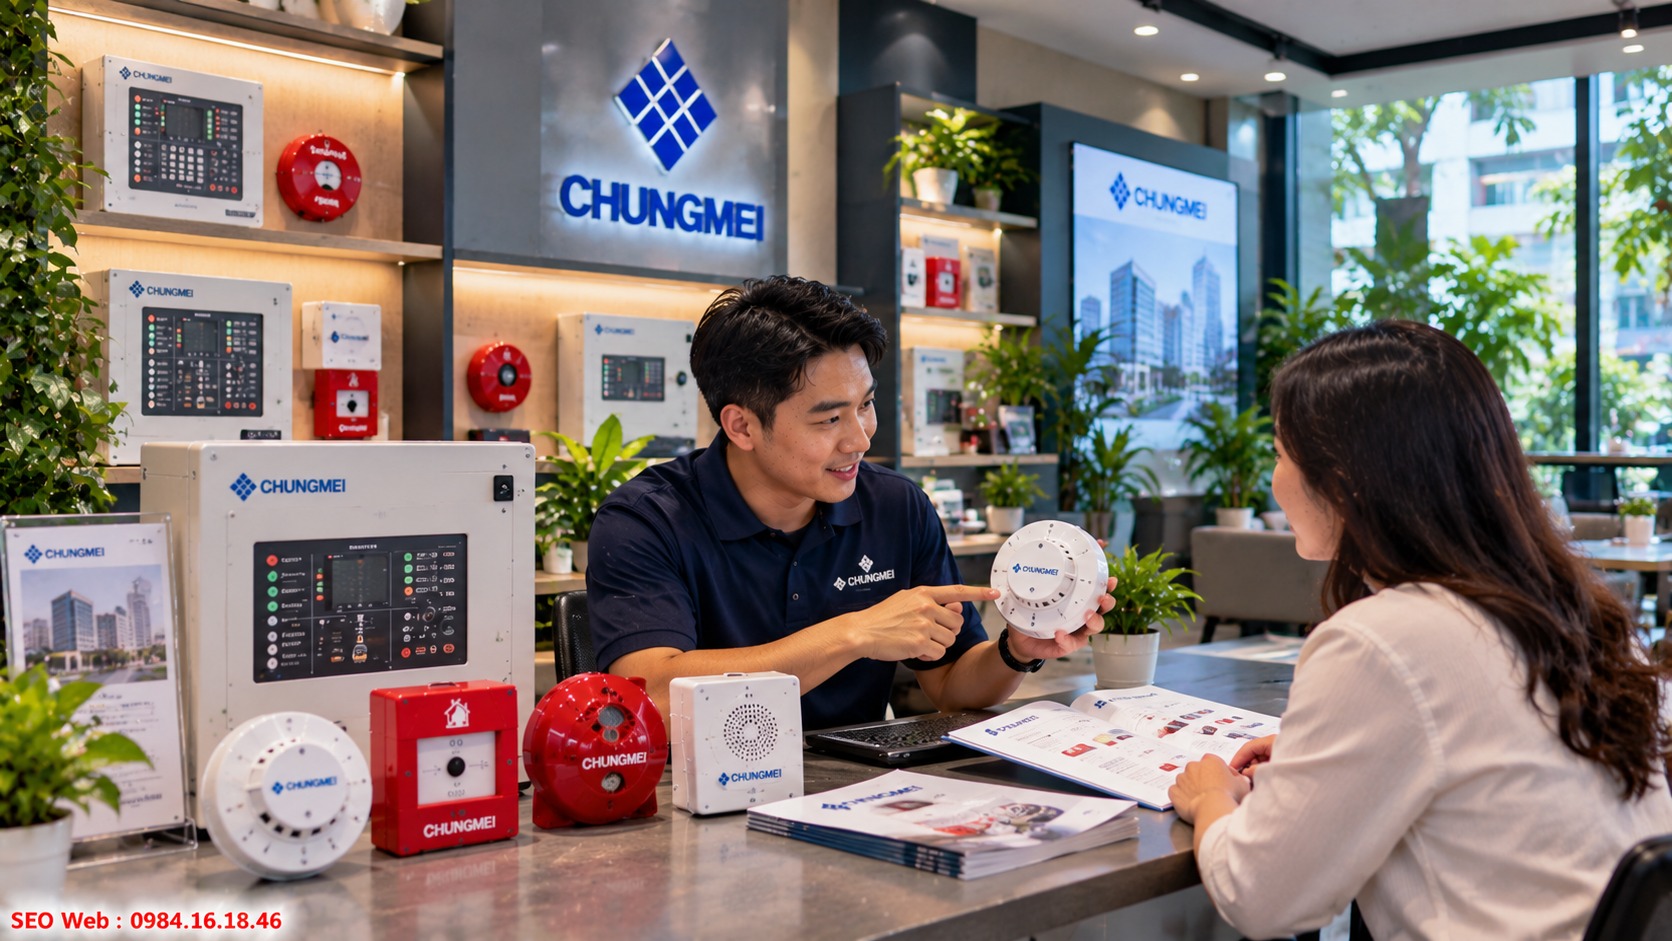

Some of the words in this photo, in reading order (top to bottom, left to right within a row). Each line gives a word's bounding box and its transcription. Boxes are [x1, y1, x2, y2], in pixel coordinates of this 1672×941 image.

[559, 174, 765, 242] CHUNGMEI
[1134, 186, 1207, 220] CHUNGMEI
[147, 286, 194, 298] CHUNGMEI
[260, 478, 346, 494] CHUNGMEI
[45, 547, 105, 559] CHUNGMEI
[847, 569, 895, 587] CHUNGMEI
[582, 751, 647, 771] CHUNGMEI
[286, 775, 338, 791] CHUNGMEI
[731, 768, 782, 783] CHUNGMEI
[423, 815, 496, 838] CHUNGMEI
